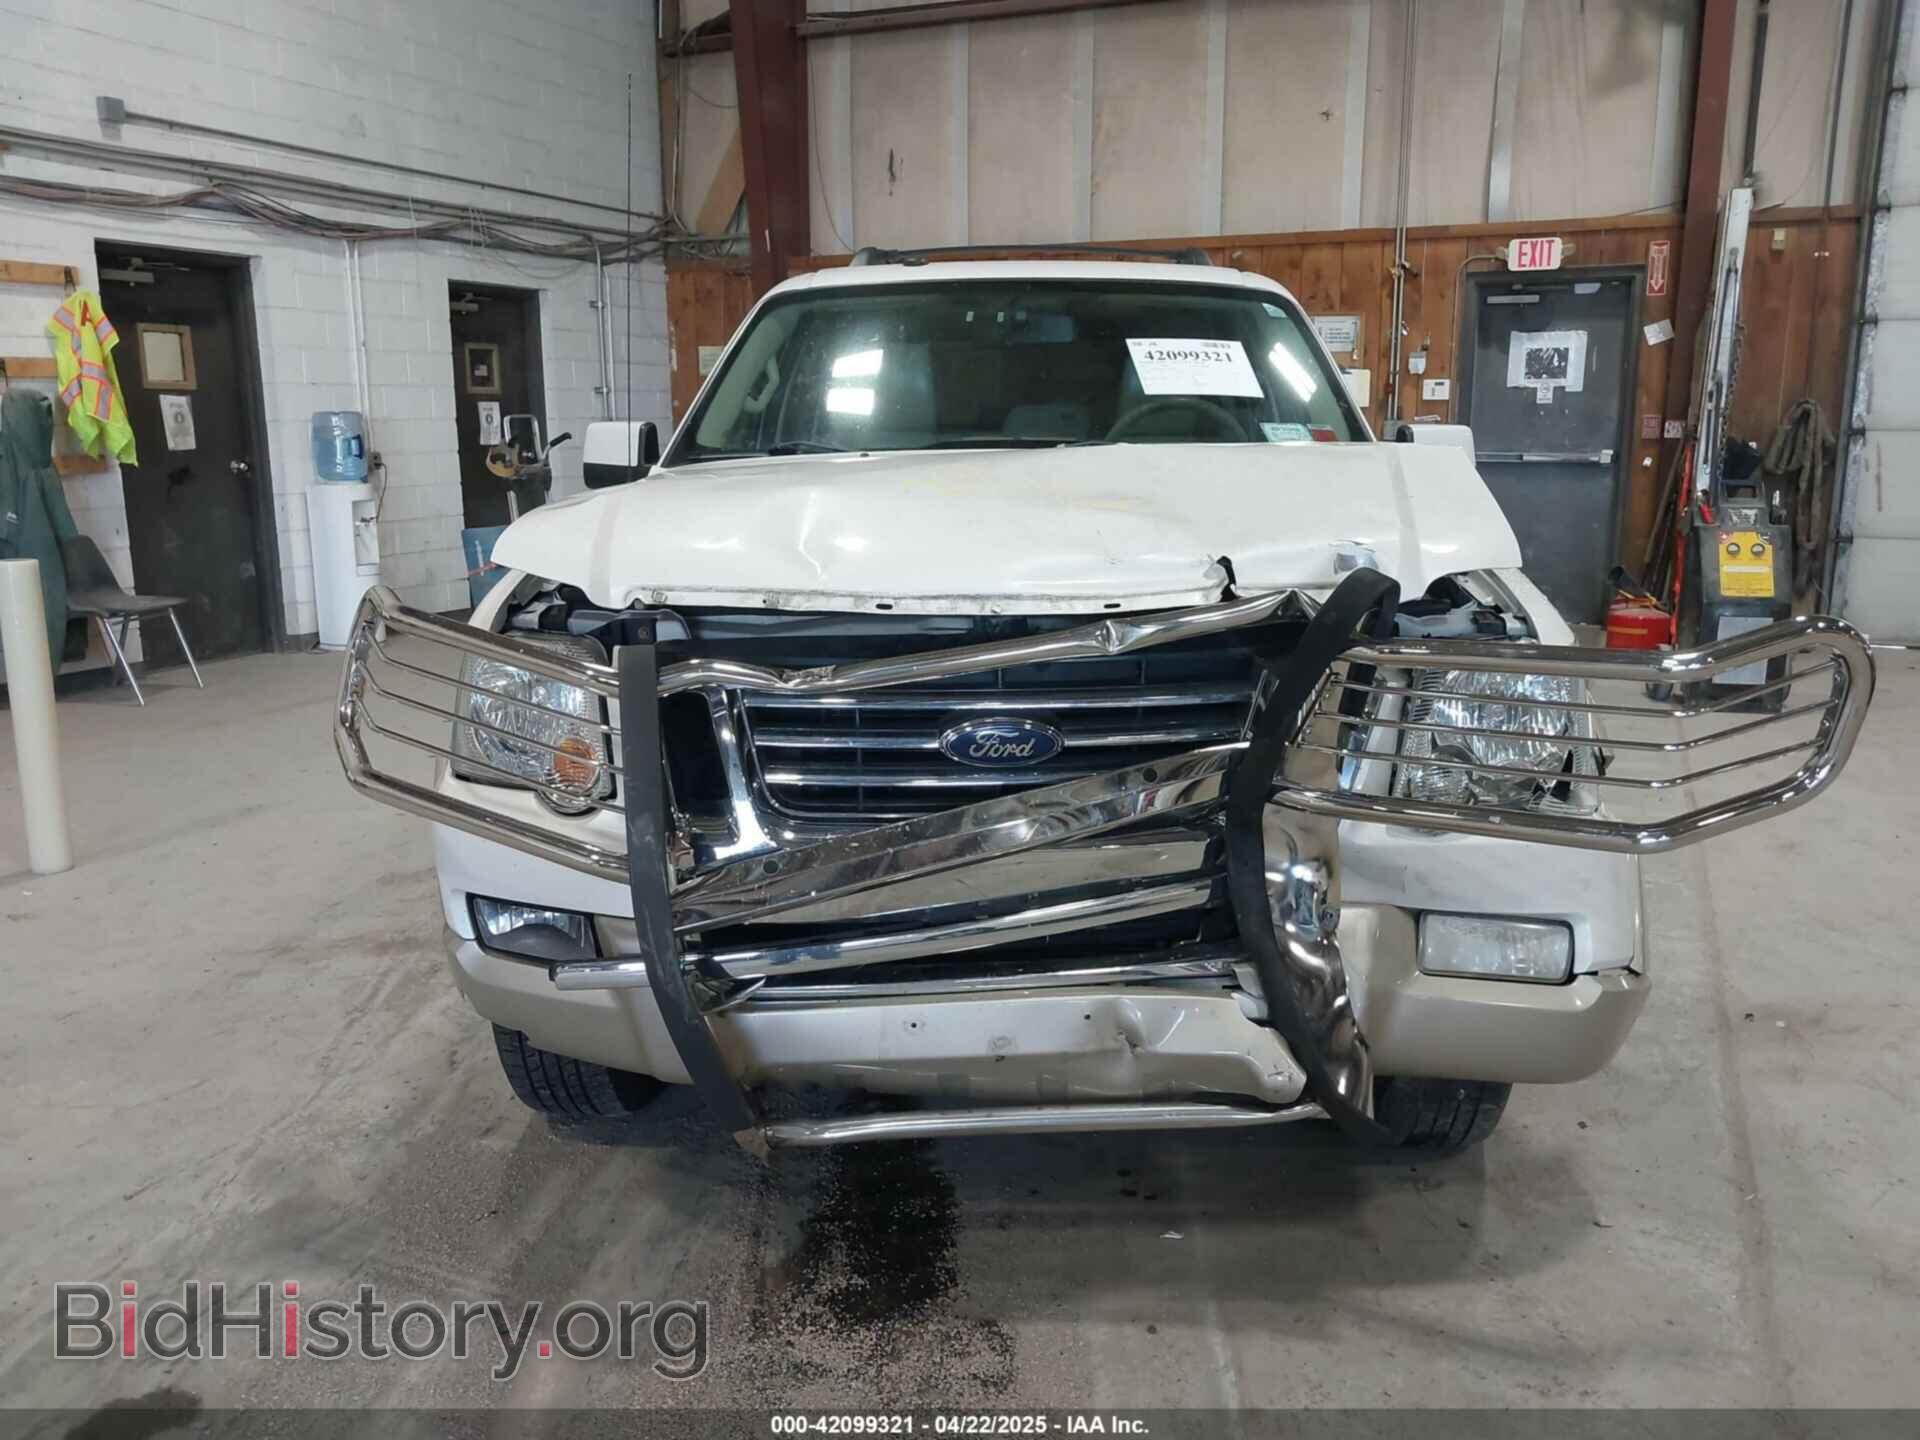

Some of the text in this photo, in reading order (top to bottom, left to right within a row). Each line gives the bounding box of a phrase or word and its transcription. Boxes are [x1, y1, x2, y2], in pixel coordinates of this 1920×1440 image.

[1517, 239, 1555, 269] EXIT
[1144, 349, 1233, 363] 42099321
[968, 729, 1036, 758] Ford
